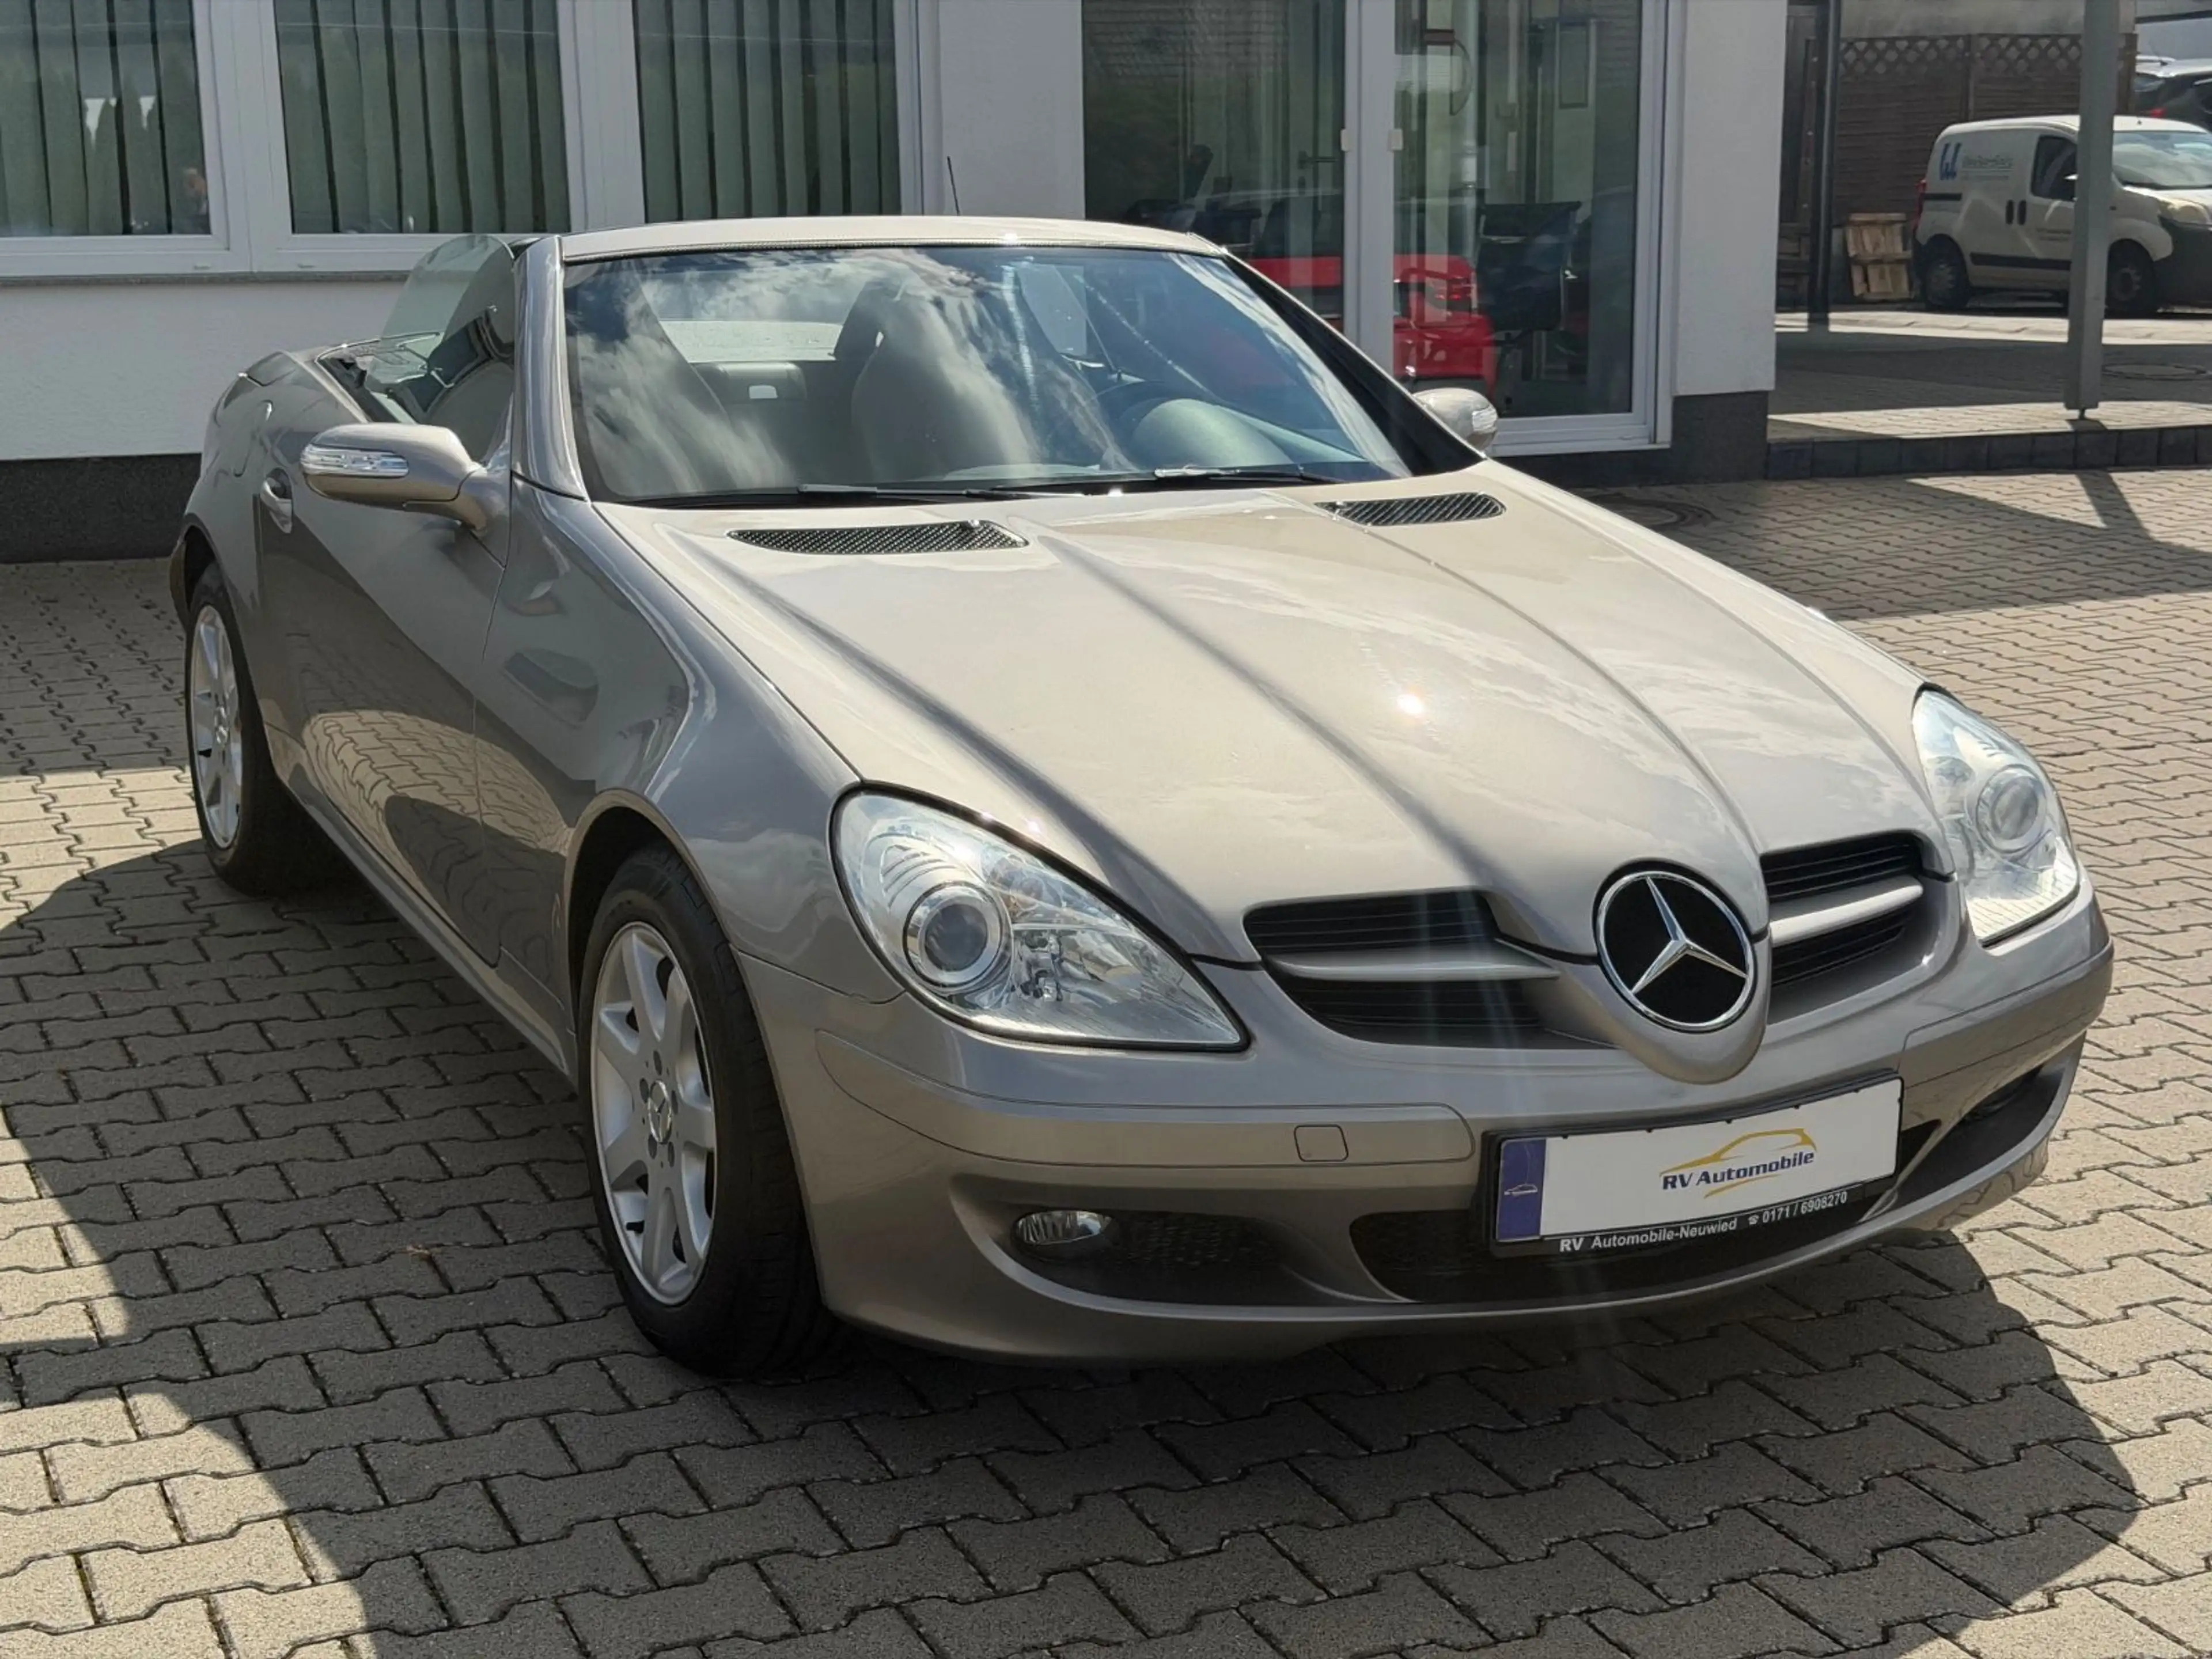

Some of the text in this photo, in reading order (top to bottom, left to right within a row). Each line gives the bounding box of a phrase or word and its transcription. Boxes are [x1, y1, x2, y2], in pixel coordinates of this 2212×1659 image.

[1662, 1151, 1815, 1190] RV Automobile
[1559, 1238, 1584, 1252] RV
[1591, 1218, 1738, 1249] Automobile-Neuwied
